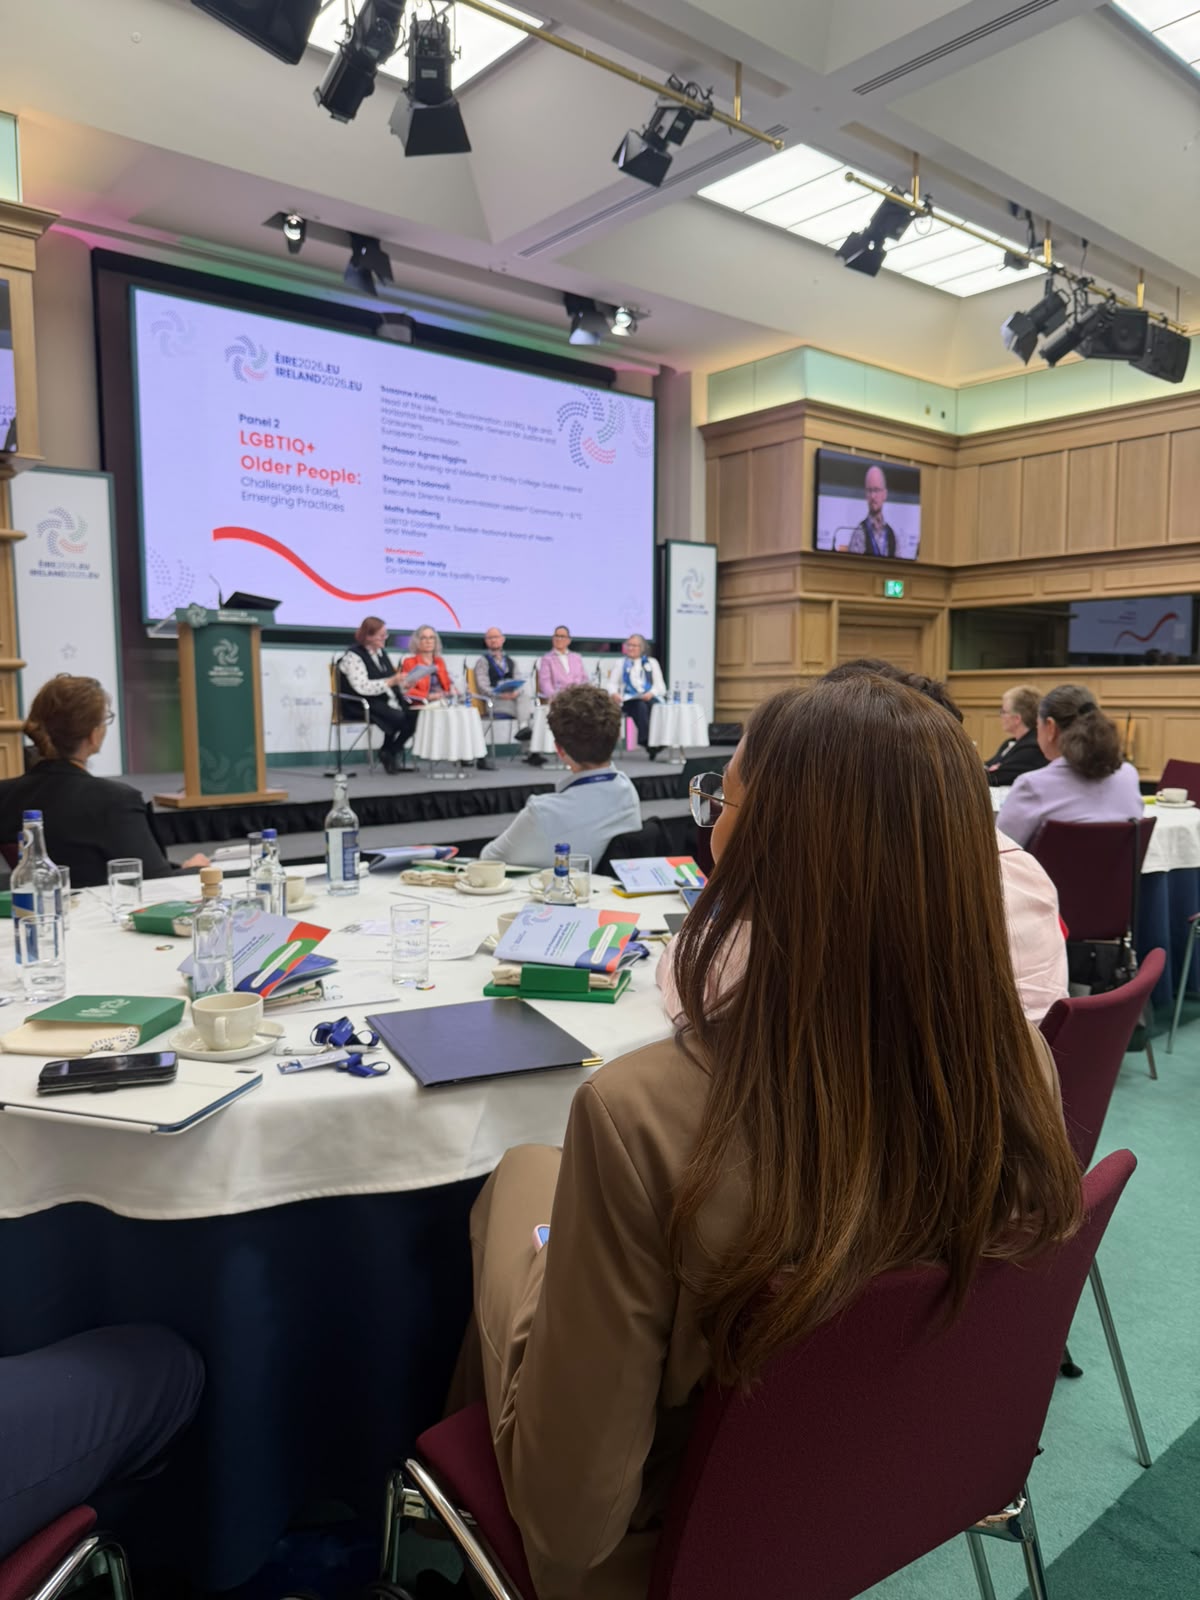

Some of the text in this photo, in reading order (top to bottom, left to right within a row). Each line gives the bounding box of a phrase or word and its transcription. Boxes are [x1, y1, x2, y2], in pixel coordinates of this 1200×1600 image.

[275, 351, 340, 375] ÉIRE2026.EU
[275, 366, 363, 392] IRELAND2026.EU
[238, 412, 281, 429] Panel 2
[239, 430, 316, 456] LGBTIQ+
[240, 454, 362, 487] Older People:
[241, 476, 341, 500] Challenges Faced,
[241, 491, 345, 512] Emerging Practices
